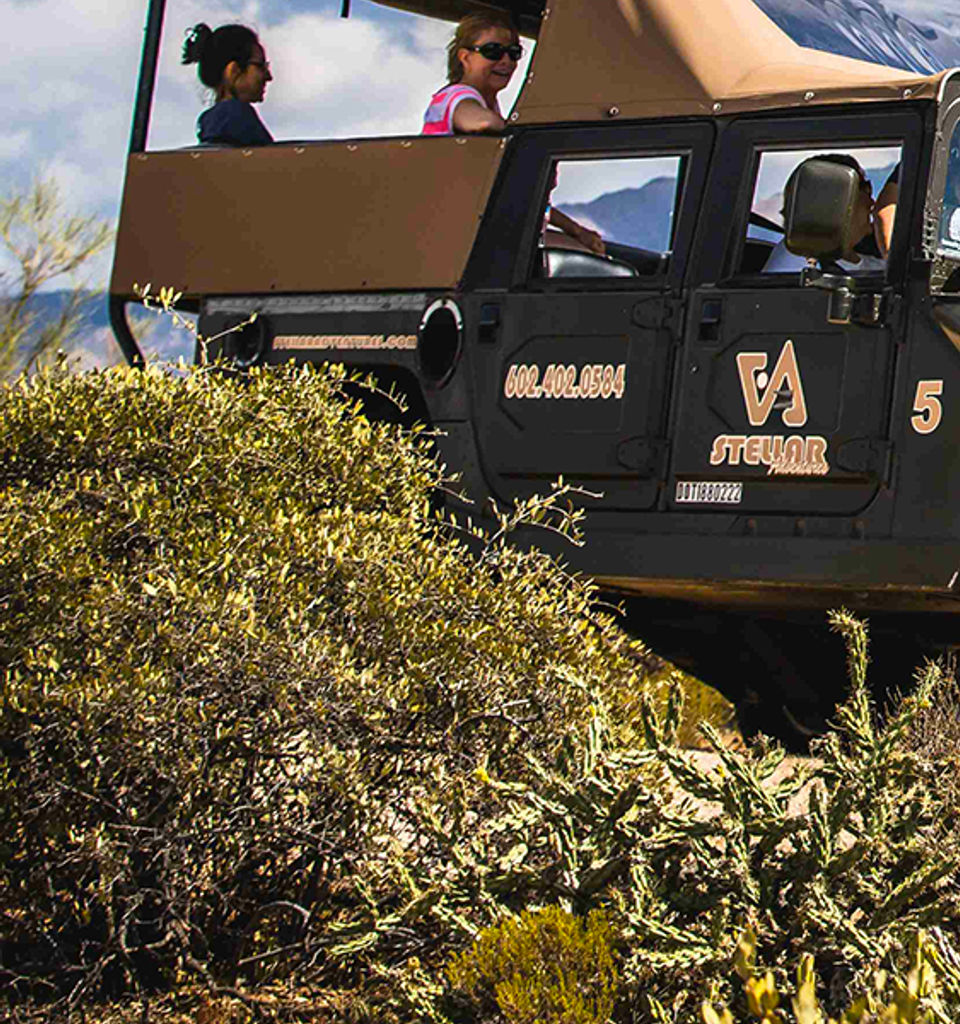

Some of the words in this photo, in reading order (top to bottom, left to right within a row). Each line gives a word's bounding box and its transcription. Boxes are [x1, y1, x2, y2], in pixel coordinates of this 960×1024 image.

[504, 364, 626, 399] 602.402.0584
[911, 379, 944, 434] 5
[709, 434, 828, 466] STELLAR
